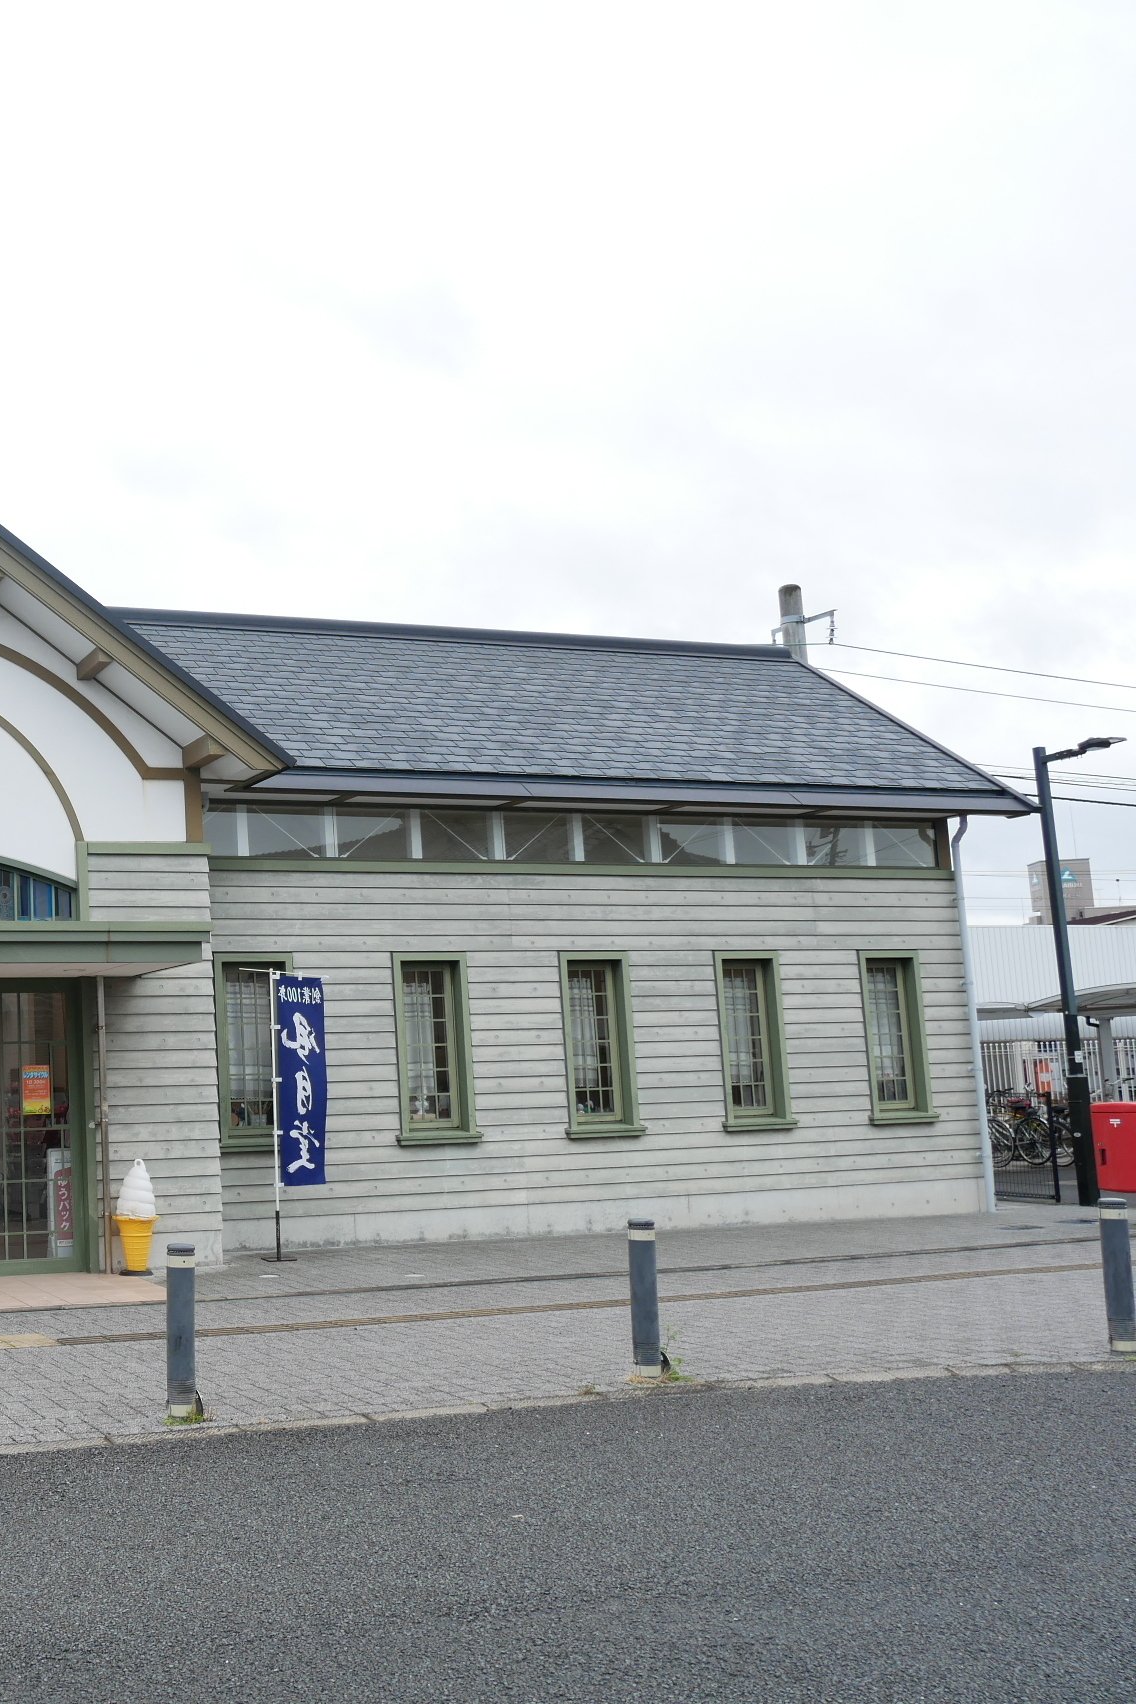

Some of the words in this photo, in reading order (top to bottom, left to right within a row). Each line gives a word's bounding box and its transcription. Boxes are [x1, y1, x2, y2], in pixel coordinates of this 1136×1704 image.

[57, 1179, 71, 1231] ゆうパック
